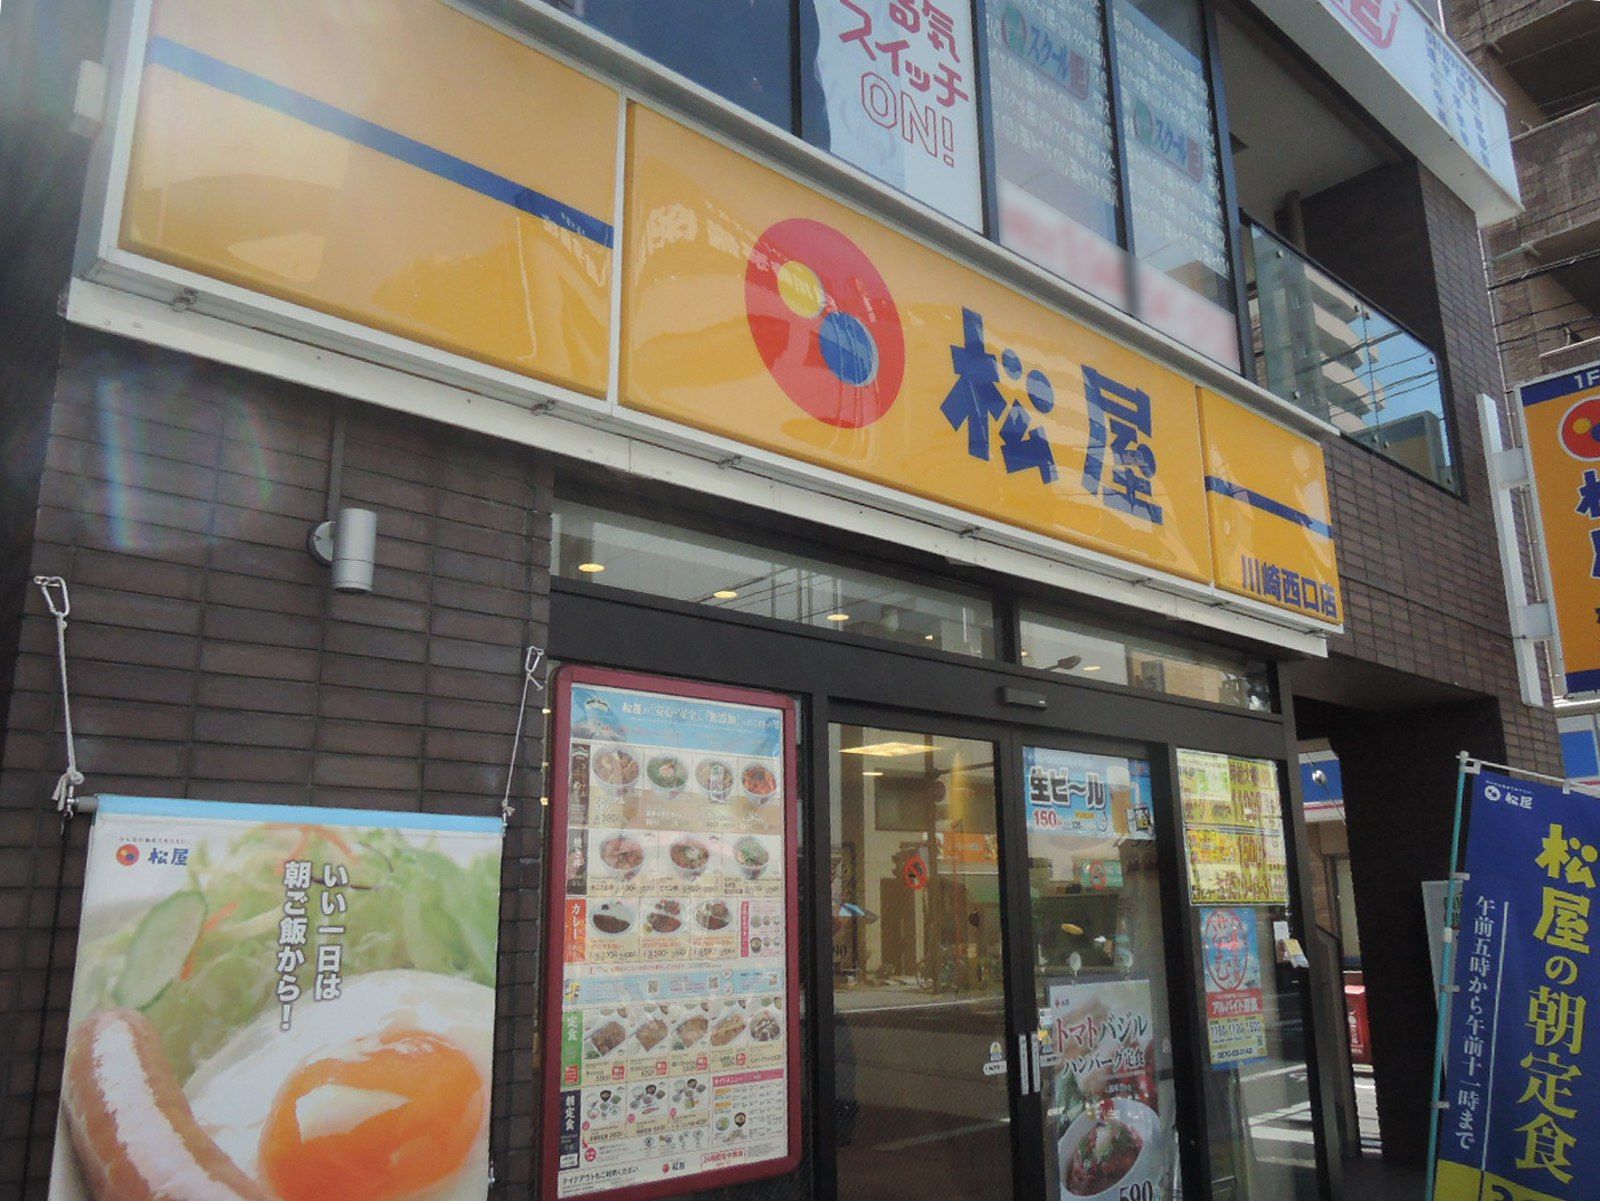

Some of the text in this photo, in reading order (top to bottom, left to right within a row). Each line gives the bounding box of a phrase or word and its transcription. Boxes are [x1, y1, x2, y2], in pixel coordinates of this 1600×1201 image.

[839, 0, 969, 107] スイッチ
[861, 72, 955, 168] ON!
[940, 306, 1163, 525] 松屋
[1241, 554, 1338, 619] 川崎西口店
[1505, 792, 1533, 809] 松屋
[147, 847, 188, 866] 松屋
[276, 860, 313, 1031] 朝ご飯から！
[313, 863, 348, 1001] いい一日は
[571, 903, 581, 940] カレー
[567, 1015, 577, 1041] 定食
[1056, 1010, 1148, 1053] トマトバジル
[1455, 896, 1496, 1150] 午前五時から午前十一時まで
[1513, 823, 1598, 1184] 松屋の朝定食
[1063, 1048, 1145, 1076] ハンバーグ定食
